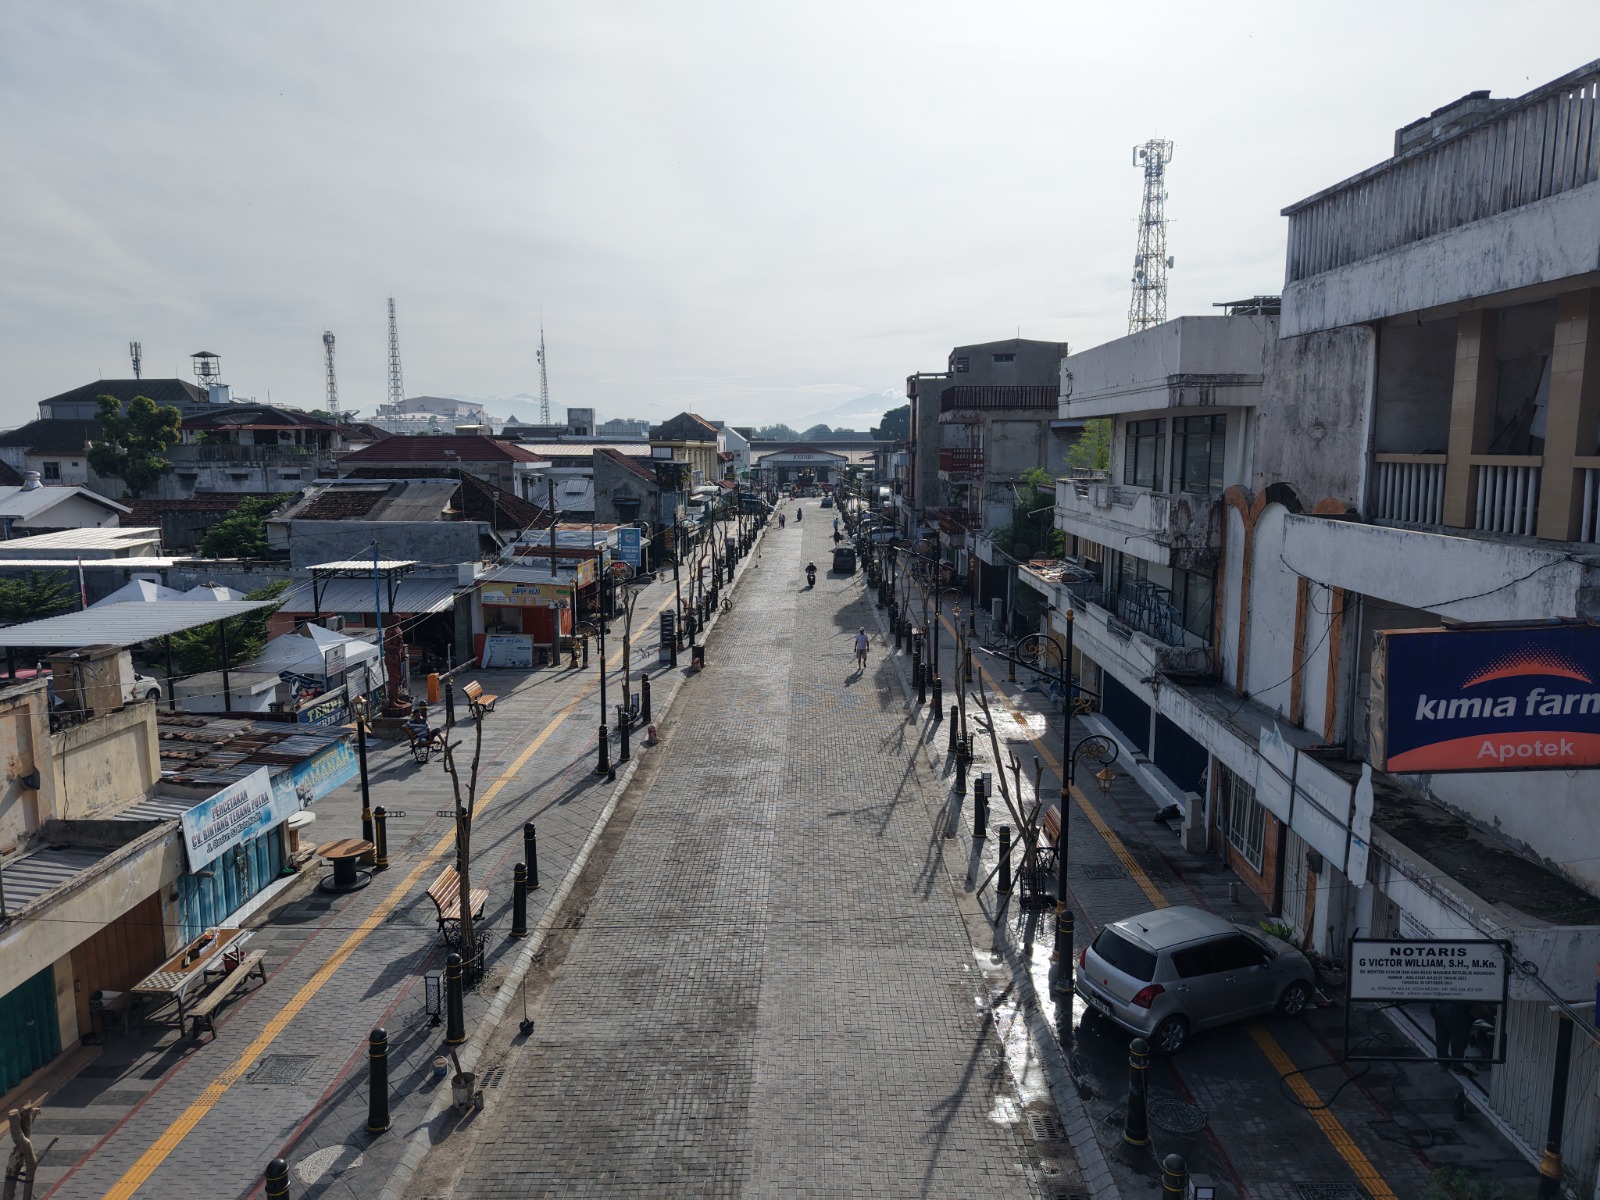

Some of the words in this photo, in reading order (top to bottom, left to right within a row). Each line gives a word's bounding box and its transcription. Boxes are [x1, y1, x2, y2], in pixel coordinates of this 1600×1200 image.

[1415, 694, 1517, 720] kimia
[1477, 738, 1575, 762] Apotek
[303, 749, 351, 790] AMANAH
[211, 789, 248, 820] PERCETAKAN
[1308, 783, 1336, 814] TOKO
[191, 834, 203, 848] CV.
[203, 816, 230, 840] BINTANG
[229, 803, 252, 826] TERANG
[252, 791, 270, 810] PUTRA
[1303, 803, 1335, 841] SURYA
[1359, 958, 1366, 967] G
[1368, 958, 1402, 967] VICTOR
[1404, 958, 1446, 969] WILLIAM,
[1448, 959, 1470, 970] S.H.,
[1472, 960, 1497, 968] M.Kn.
[1390, 947, 1467, 957] NOTARIS
